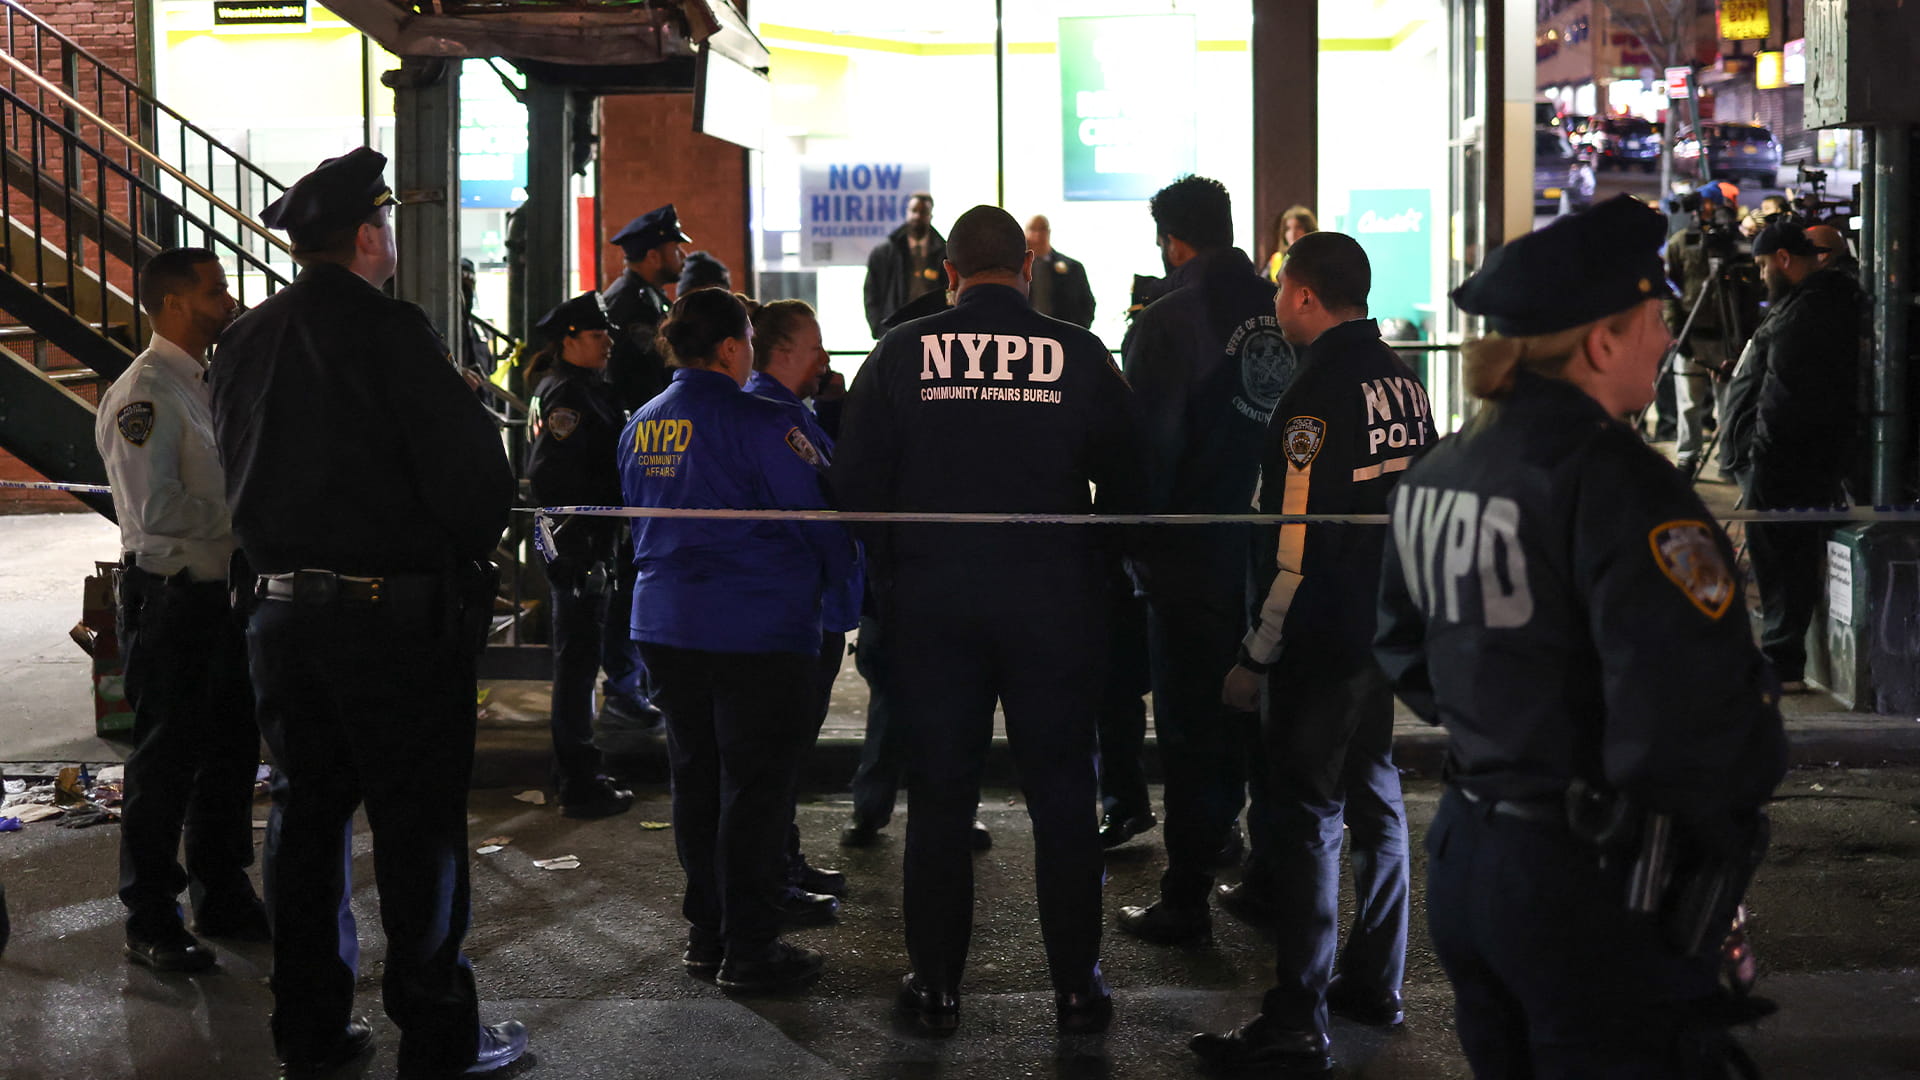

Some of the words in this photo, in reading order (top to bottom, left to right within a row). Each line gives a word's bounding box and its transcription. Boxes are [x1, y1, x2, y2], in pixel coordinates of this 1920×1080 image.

[829, 164, 902, 190] NOW
[1244, 318, 1256, 330] OF
[1258, 315, 1276, 327] THE
[920, 333, 1064, 382] NYPD
[921, 386, 979, 401] COMMUNITY
[980, 387, 1021, 401] AFFAIRS
[1023, 388, 1062, 404] BUREAU
[634, 419, 693, 453] NYPD
[1369, 421, 1427, 455] POLI
[638, 455, 682, 465] COMMUNITY
[646, 467, 676, 477] AFFAIRS
[1394, 484, 1534, 628] NYPD
